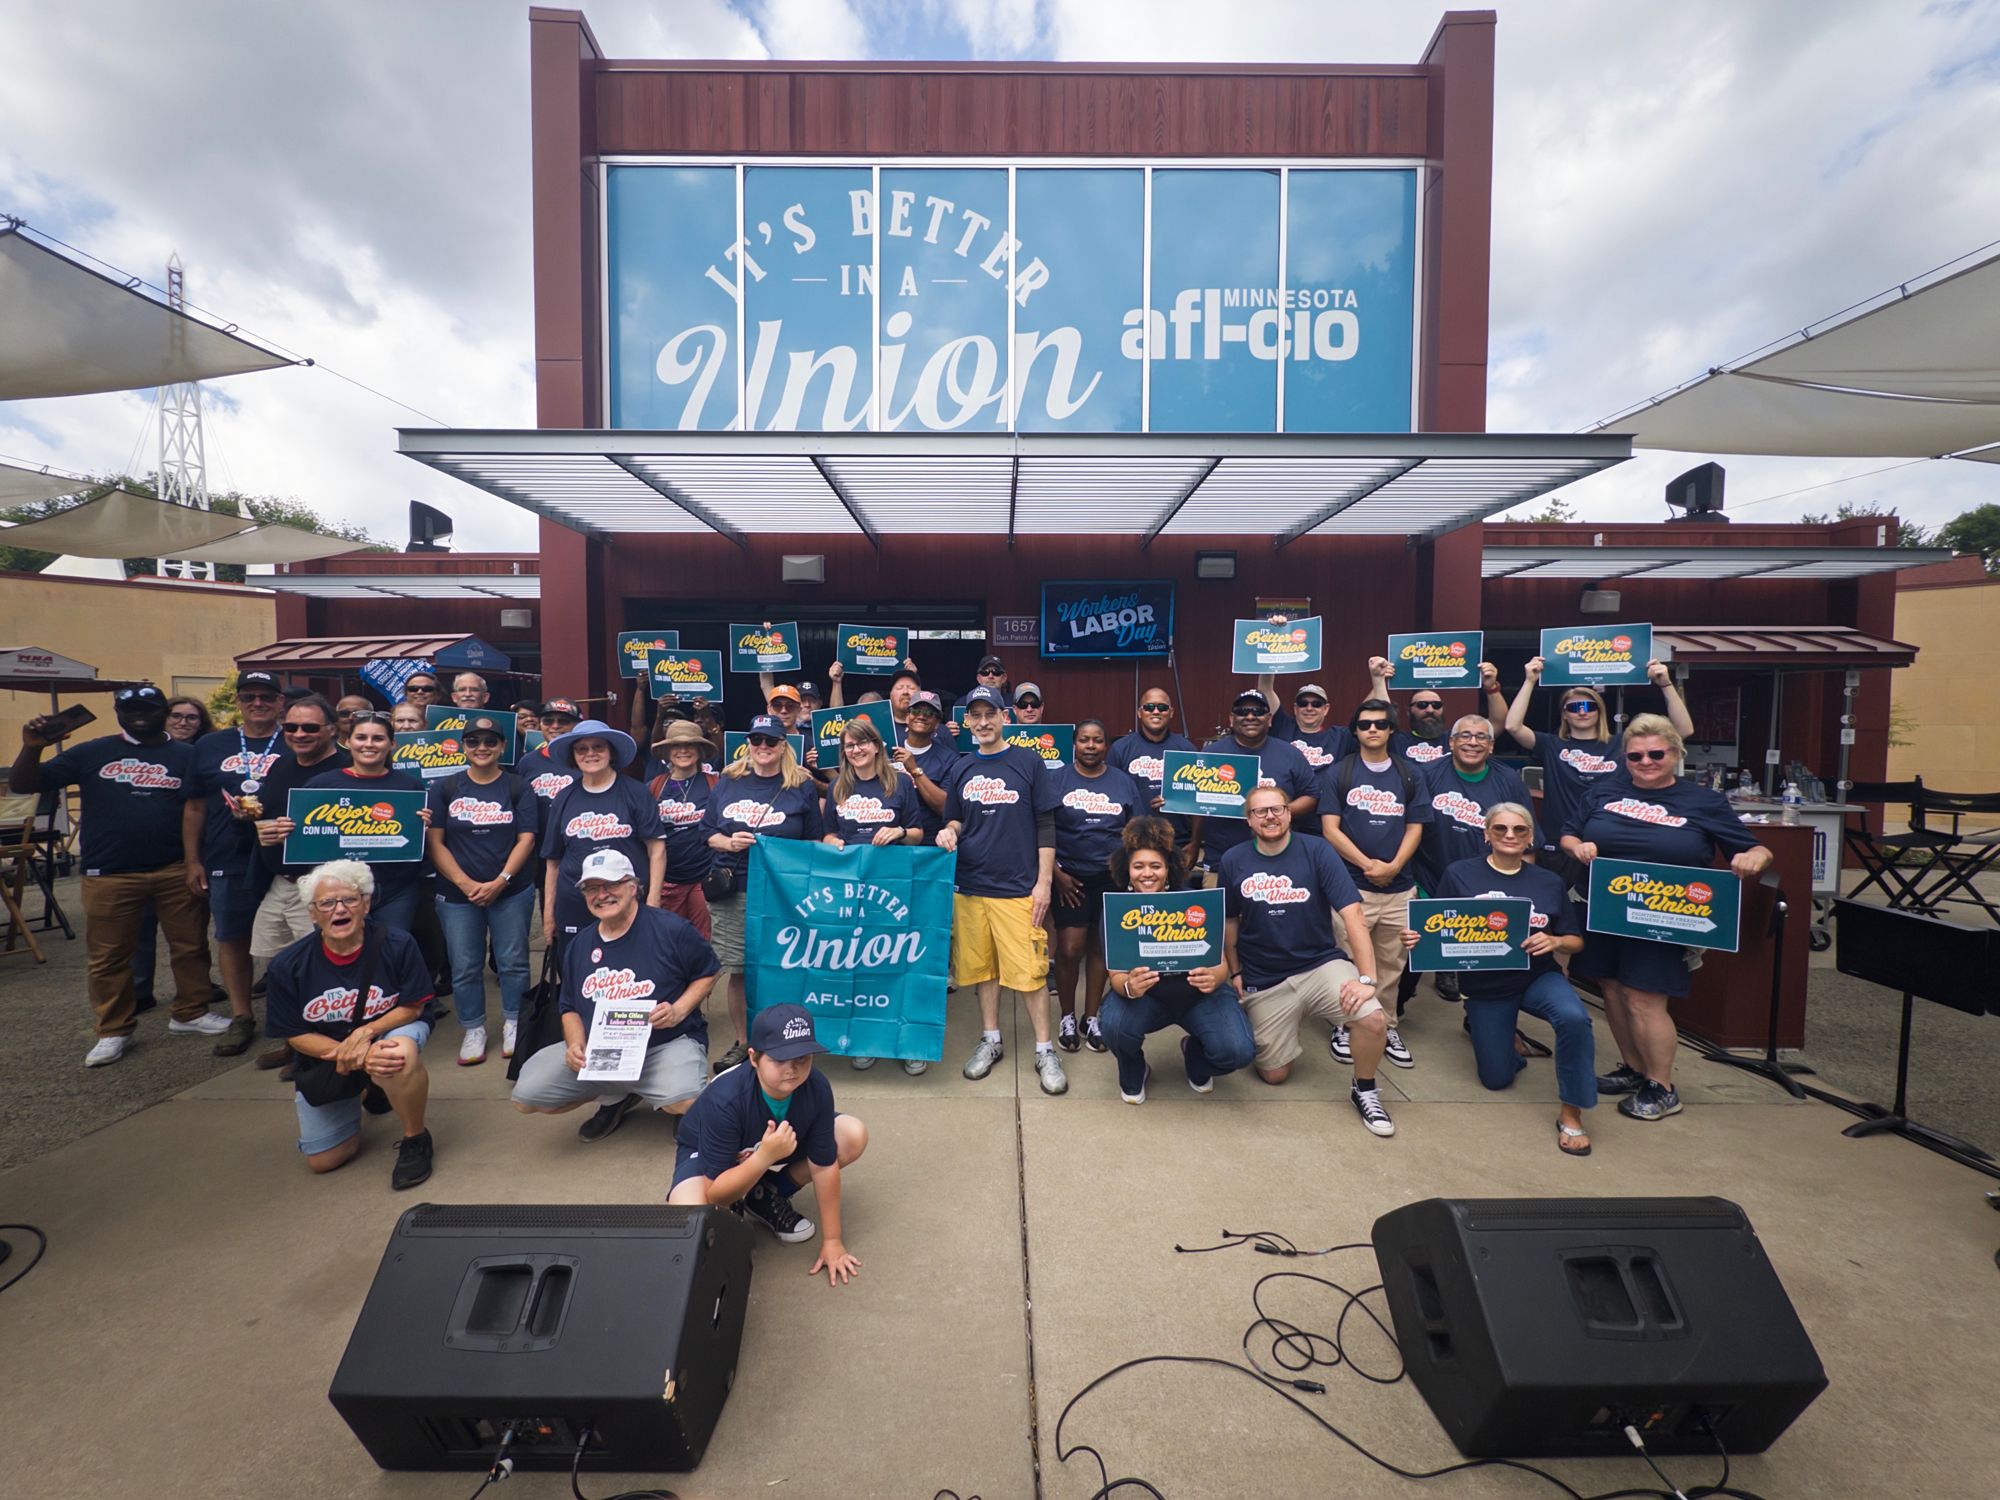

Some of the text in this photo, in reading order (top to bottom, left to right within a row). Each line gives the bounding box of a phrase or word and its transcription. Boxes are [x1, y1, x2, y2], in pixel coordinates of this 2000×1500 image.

[705, 189, 1050, 306] IT'S BETTER
[840, 265, 919, 296] IN A
[1224, 288, 1359, 308] MINNESOTA
[1121, 288, 1360, 361] afl-cio
[656, 311, 1103, 430] Union
[1004, 620, 1036, 632] 1657
[1070, 604, 1155, 639] LABOR
[739, 635, 773, 648] Mejor
[847, 635, 886, 648] Better
[1114, 623, 1158, 647] Day
[1245, 631, 1293, 645] Better
[1573, 635, 1584, 643] IT'S
[865, 646, 897, 656] Union
[1267, 642, 1307, 653] Union
[1400, 644, 1451, 660] Better
[1555, 639, 1613, 654] Better
[1424, 655, 1466, 667] Union
[1582, 650, 1632, 662] Union
[655, 660, 689, 675] Mejor
[392, 743, 443, 762] Mejor
[100, 762, 164, 777] Better
[1173, 764, 1220, 782] Mejor
[132, 774, 181, 787] Union
[964, 780, 1003, 798] Better
[339, 797, 350, 806] ES
[980, 791, 1017, 802] Union
[1065, 793, 1105, 806] Better
[1348, 790, 1393, 804] Better
[1434, 795, 1478, 812] Better
[451, 801, 500, 815] Better
[1086, 802, 1120, 812] Union
[1370, 802, 1403, 814] Union
[304, 804, 373, 825] Mejor
[471, 811, 512, 823] Union
[856, 810, 893, 821] Union
[303, 819, 402, 835] CON UNA Unión
[568, 815, 615, 833] Better
[591, 825, 631, 839] Union
[1632, 872, 1649, 882] IT'S
[1242, 879, 1289, 896] Better
[1608, 876, 1686, 898] Better
[1689, 885, 1712, 896] Labor
[795, 883, 909, 921] IT'S BETTER
[1266, 889, 1307, 901] Union
[1689, 891, 1706, 900] Day!
[1141, 904, 1155, 914] IT'S
[1627, 892, 1712, 916] IN A Union
[839, 907, 865, 918] IN A
[1121, 909, 1187, 930] Better
[1443, 910, 1457, 918] IT'S
[1424, 914, 1488, 932] Better
[1138, 925, 1207, 941] IN A Union
[1441, 928, 1508, 942] IN A Union
[776, 926, 927, 970] Union
[597, 970, 607, 979] IT'S
[585, 971, 632, 993] Better
[326, 989, 343, 1000] IT'S
[605, 983, 650, 1000] Union
[306, 989, 379, 1019] Bettr
[805, 992, 889, 1007] AFL-CIO
[336, 1012, 342, 1020] A
[783, 1027, 810, 1040] Union
